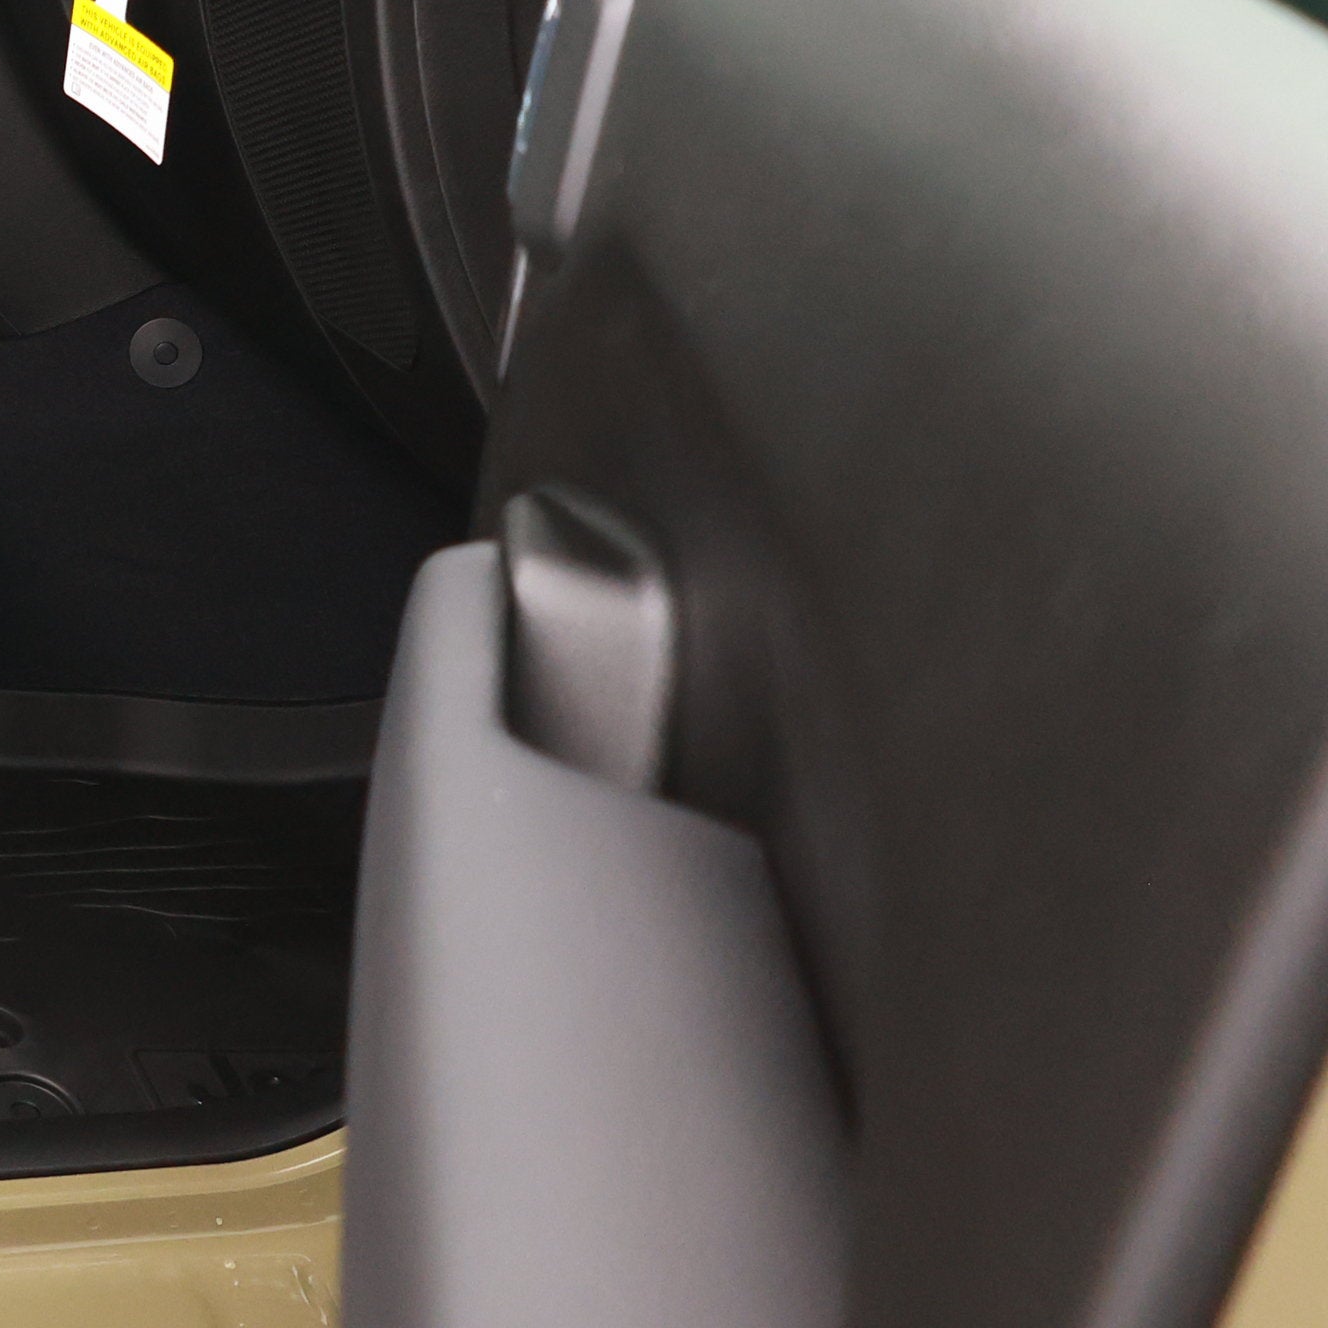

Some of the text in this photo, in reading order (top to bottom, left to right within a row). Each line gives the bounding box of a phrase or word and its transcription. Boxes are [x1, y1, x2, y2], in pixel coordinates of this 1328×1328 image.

[80, 18, 99, 34] WITH
[100, 30, 136, 61] ADVANCED
[138, 58, 149, 69] AIR
[82, 5, 98, 21] THIS
[100, 16, 127, 39] VEHICLE
[137, 41, 168, 71] EQUIPPED
